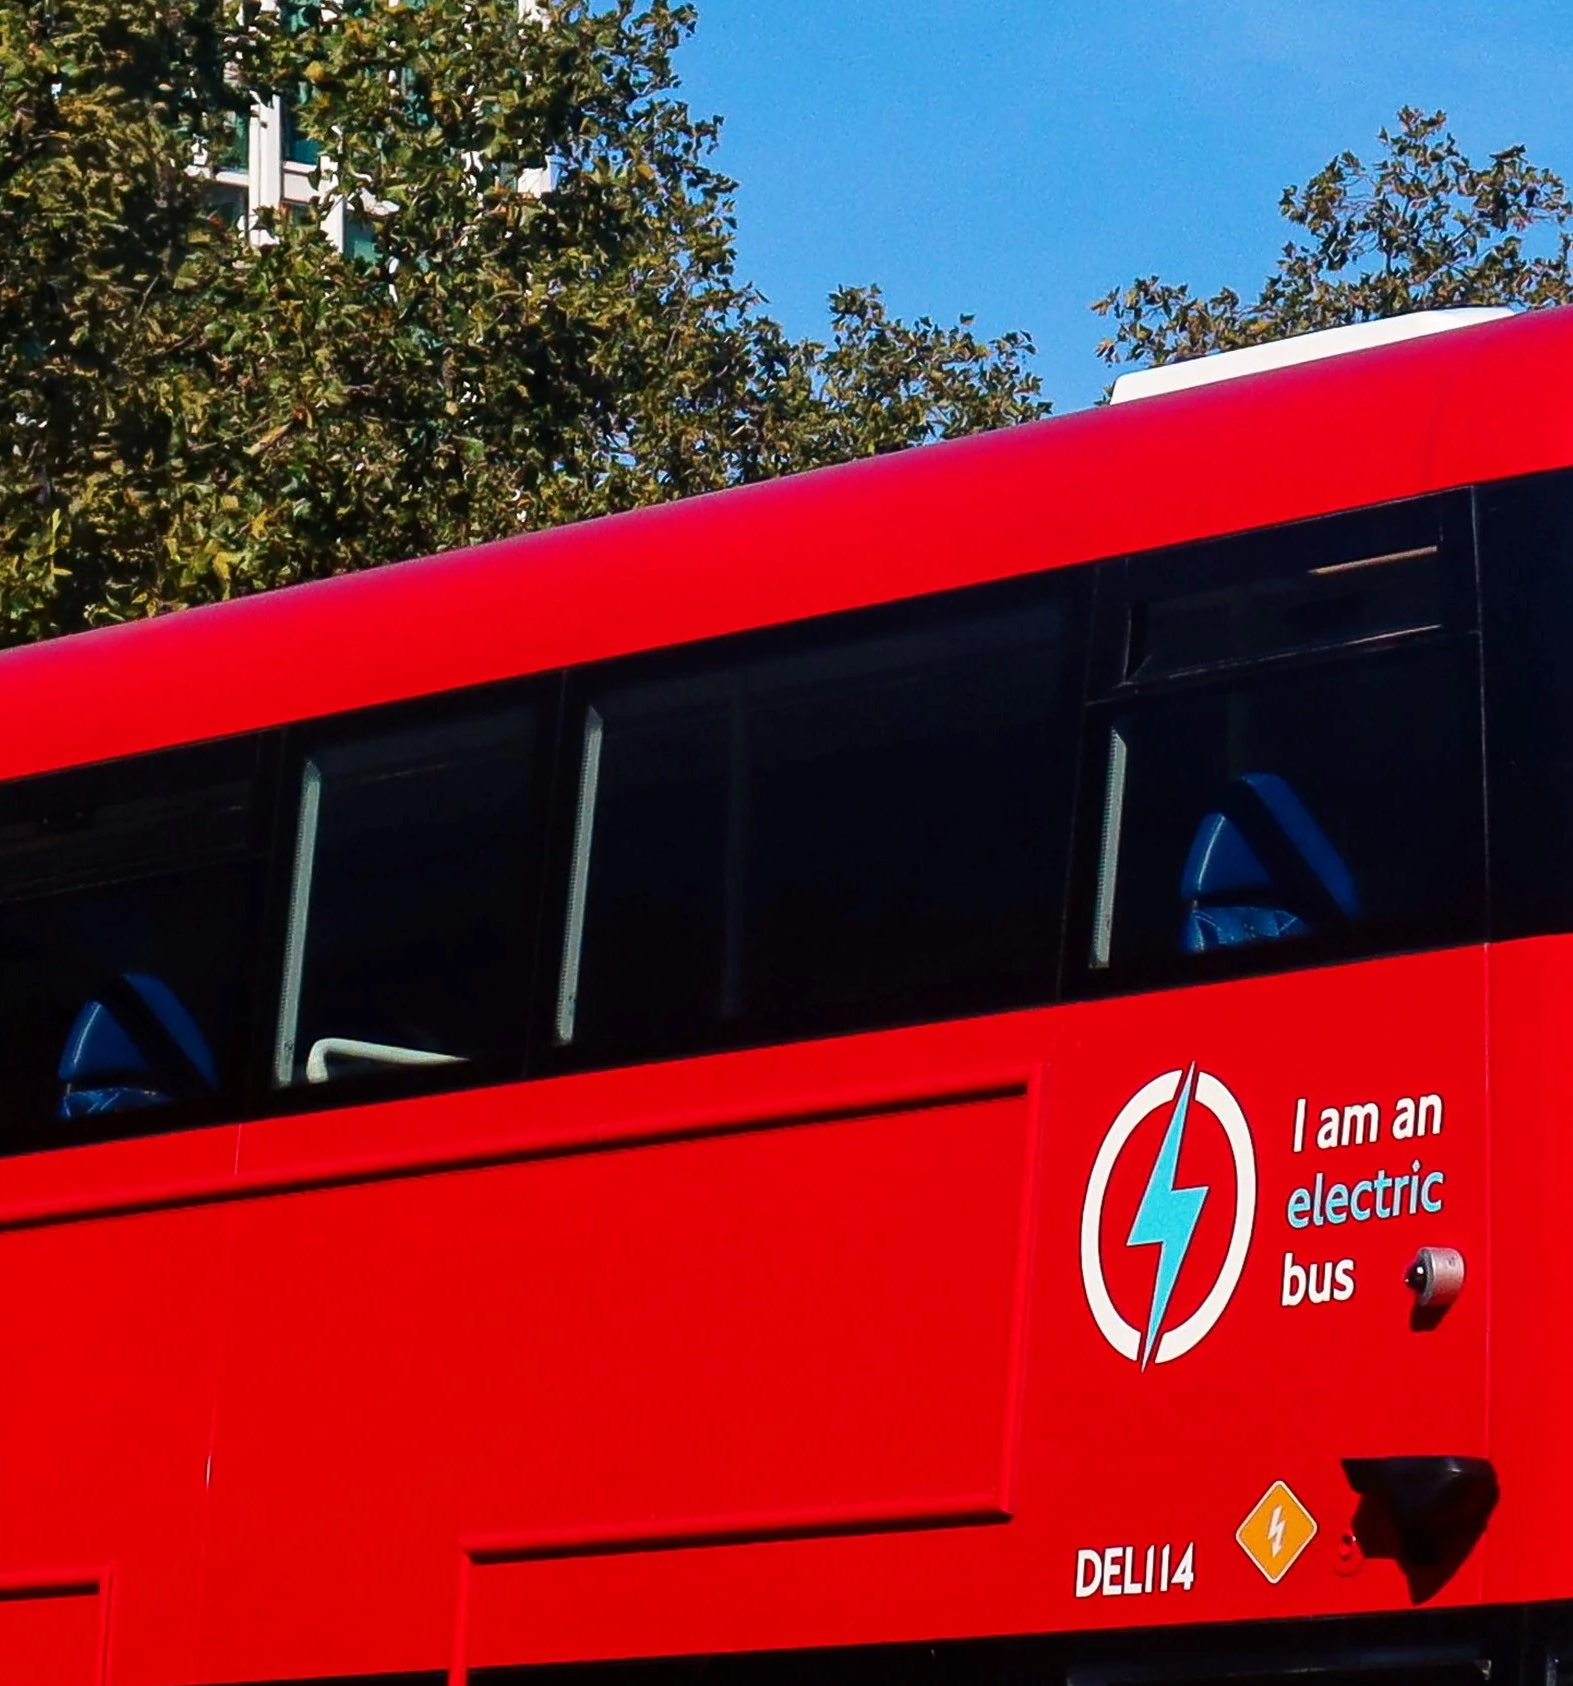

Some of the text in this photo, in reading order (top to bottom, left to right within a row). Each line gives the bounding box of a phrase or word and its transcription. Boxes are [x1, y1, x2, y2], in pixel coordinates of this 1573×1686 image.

[1293, 1093, 1443, 1152] I am an
[1286, 1159, 1444, 1229] electric
[1281, 1252, 1355, 1307] bus
